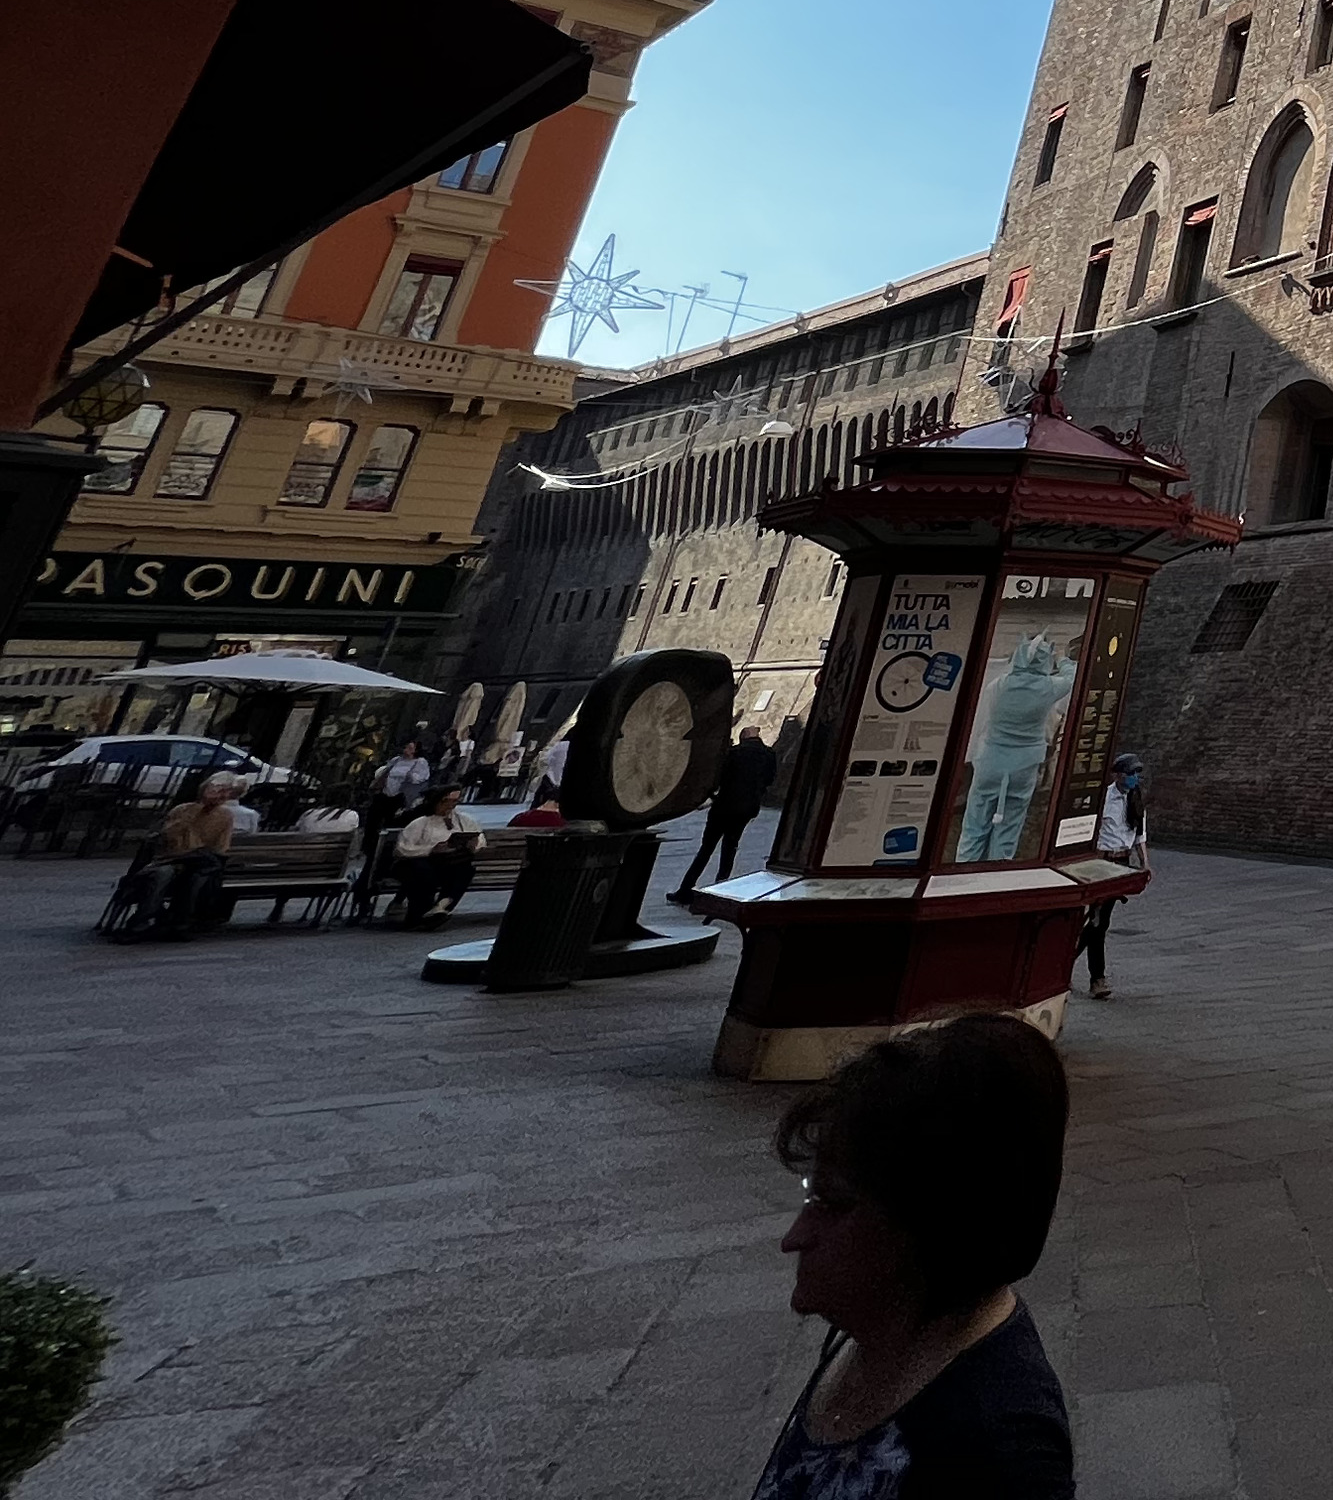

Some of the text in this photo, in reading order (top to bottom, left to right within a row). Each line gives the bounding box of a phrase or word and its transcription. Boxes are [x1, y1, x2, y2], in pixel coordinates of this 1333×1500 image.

[894, 593, 951, 610] TUTTA
[887, 613, 951, 631] MIA LA
